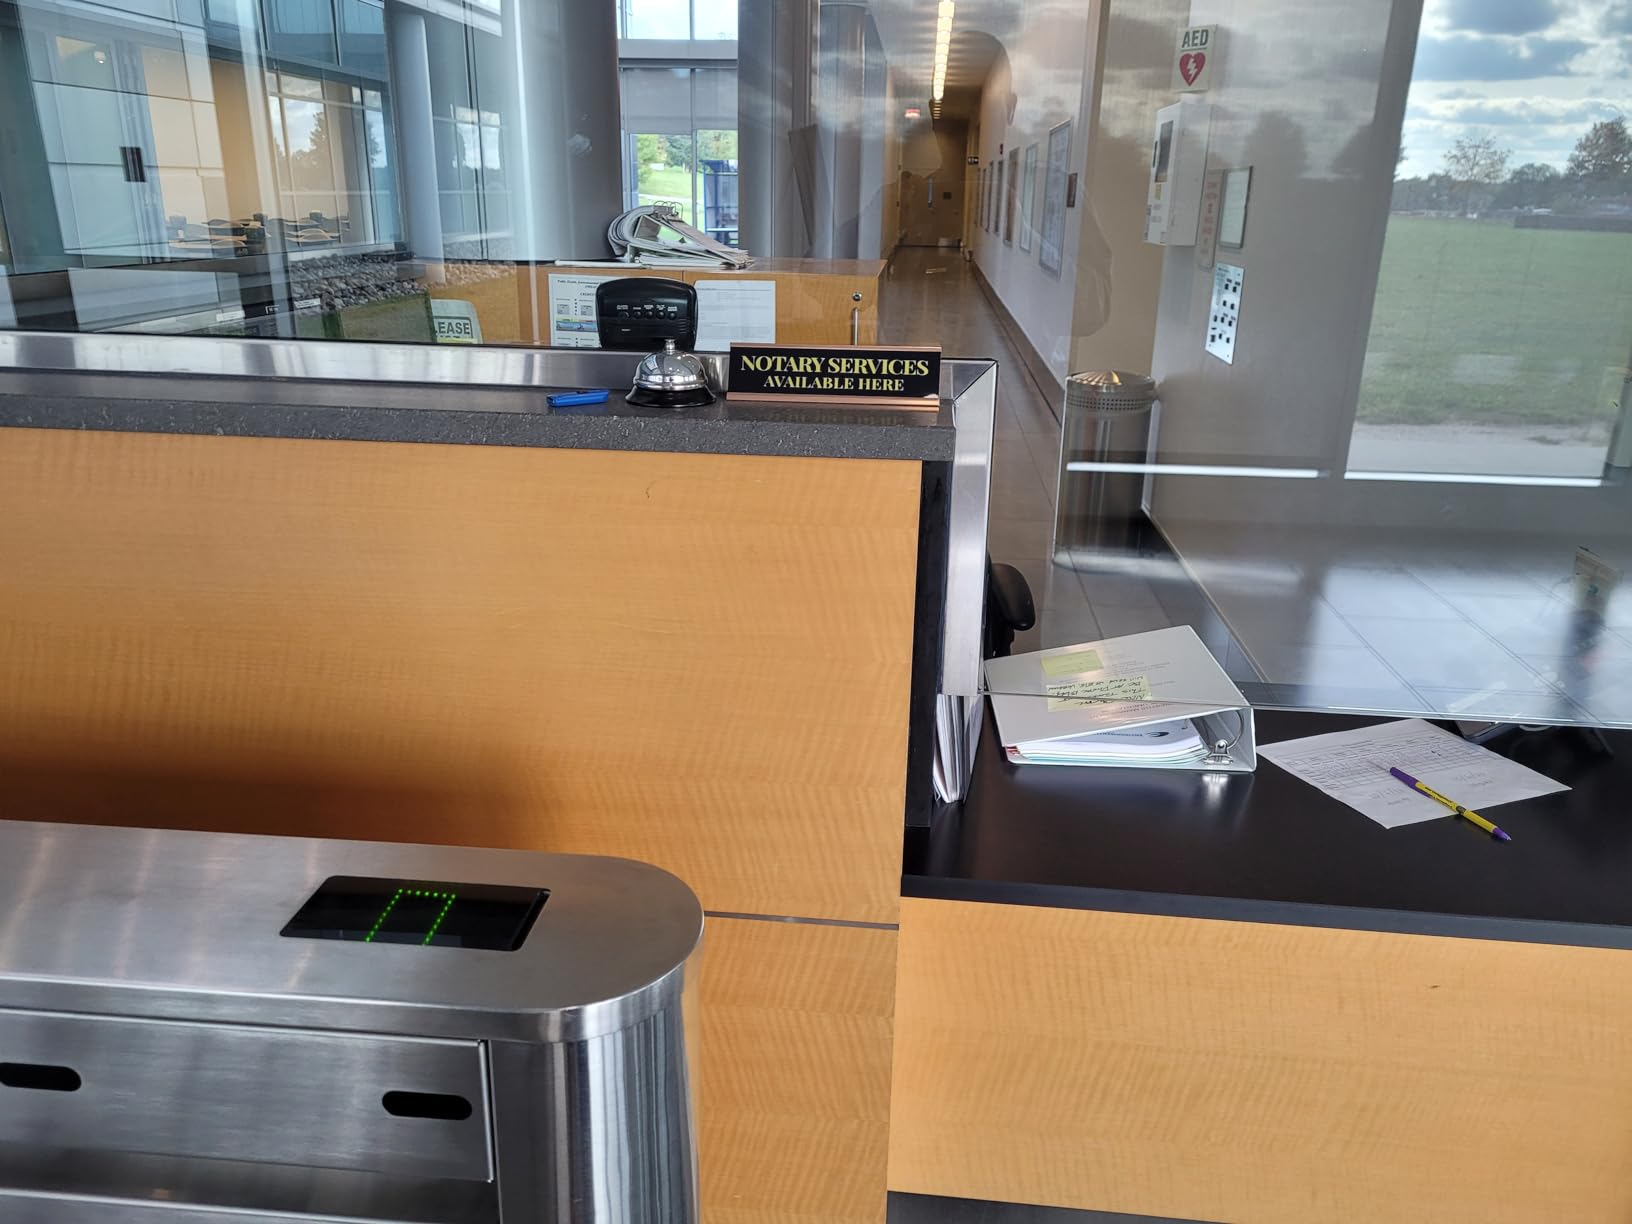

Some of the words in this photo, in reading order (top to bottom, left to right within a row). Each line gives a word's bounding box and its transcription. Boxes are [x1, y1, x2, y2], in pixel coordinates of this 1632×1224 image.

[1182, 29, 1209, 48] AED
[435, 321, 470, 335] EASE
[741, 355, 825, 373] NOTARY
[828, 357, 929, 376] SERVICES
[764, 375, 854, 390] AVAILABLE
[858, 378, 904, 391] HERE
